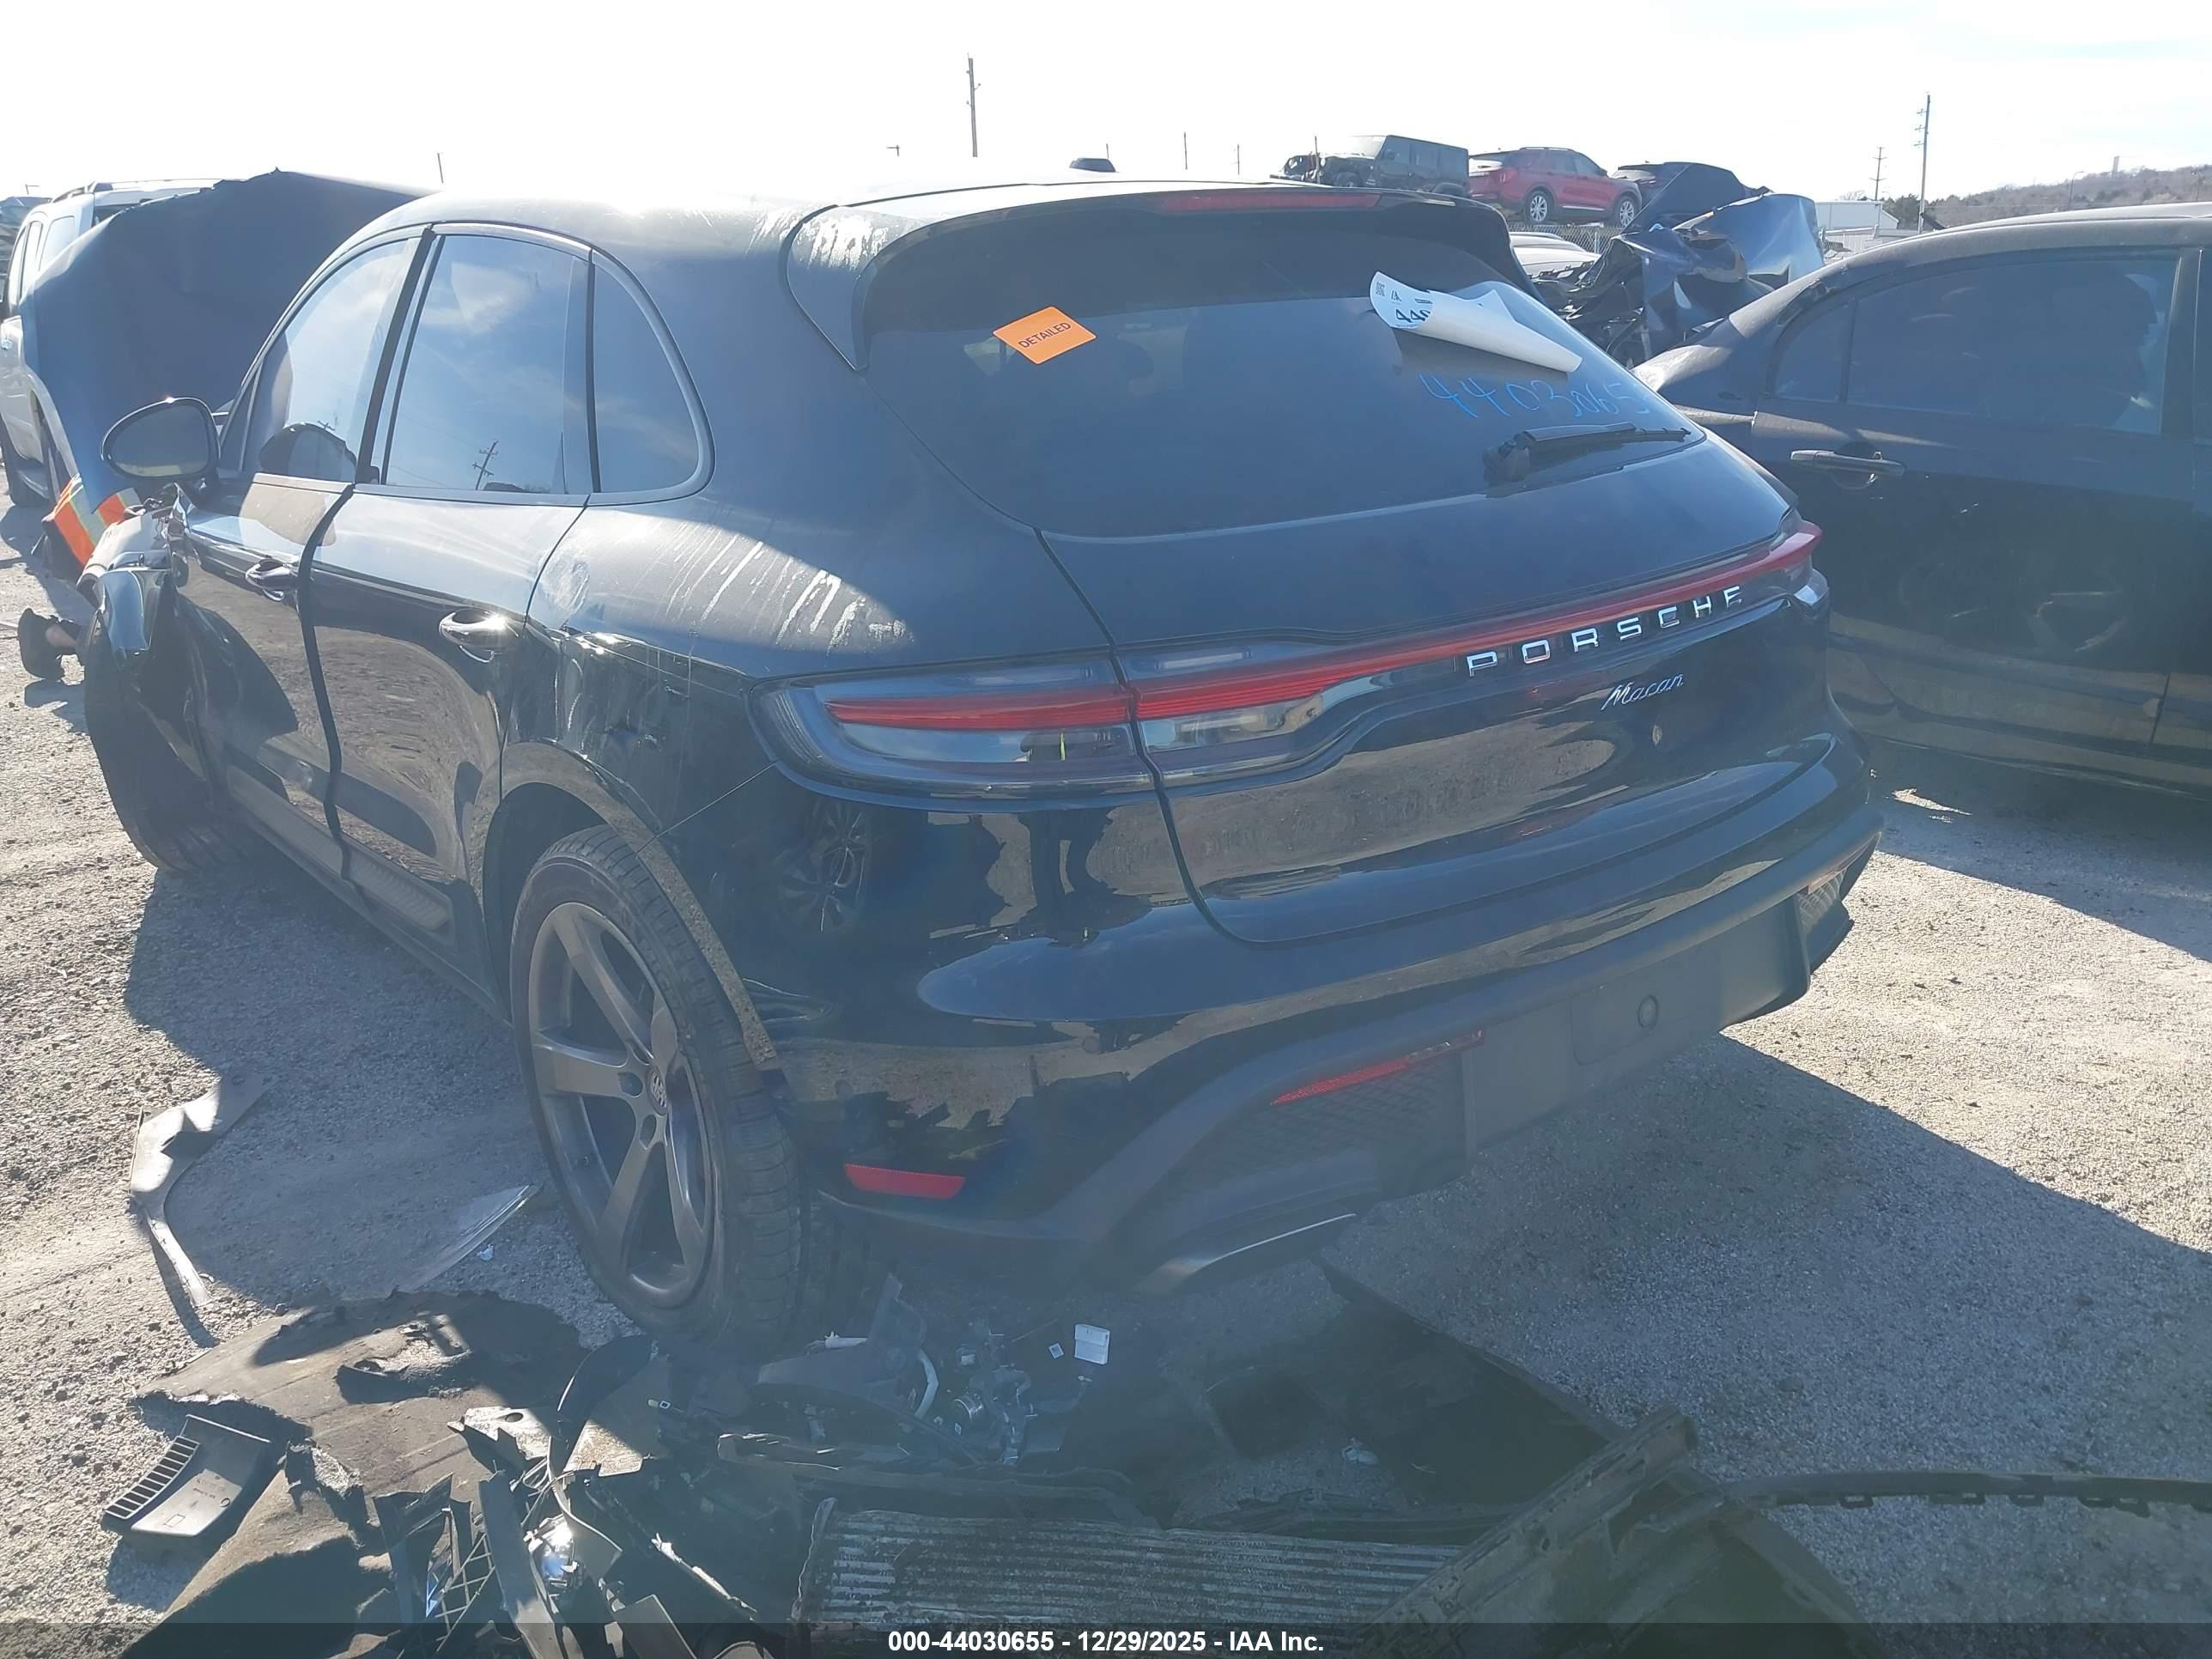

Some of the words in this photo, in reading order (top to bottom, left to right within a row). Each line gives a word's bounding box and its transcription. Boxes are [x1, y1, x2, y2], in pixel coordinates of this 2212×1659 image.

[1018, 322, 1072, 348] DETAILED
[1466, 585, 1743, 678] PORSCHE
[1601, 672, 1684, 711] Macan
